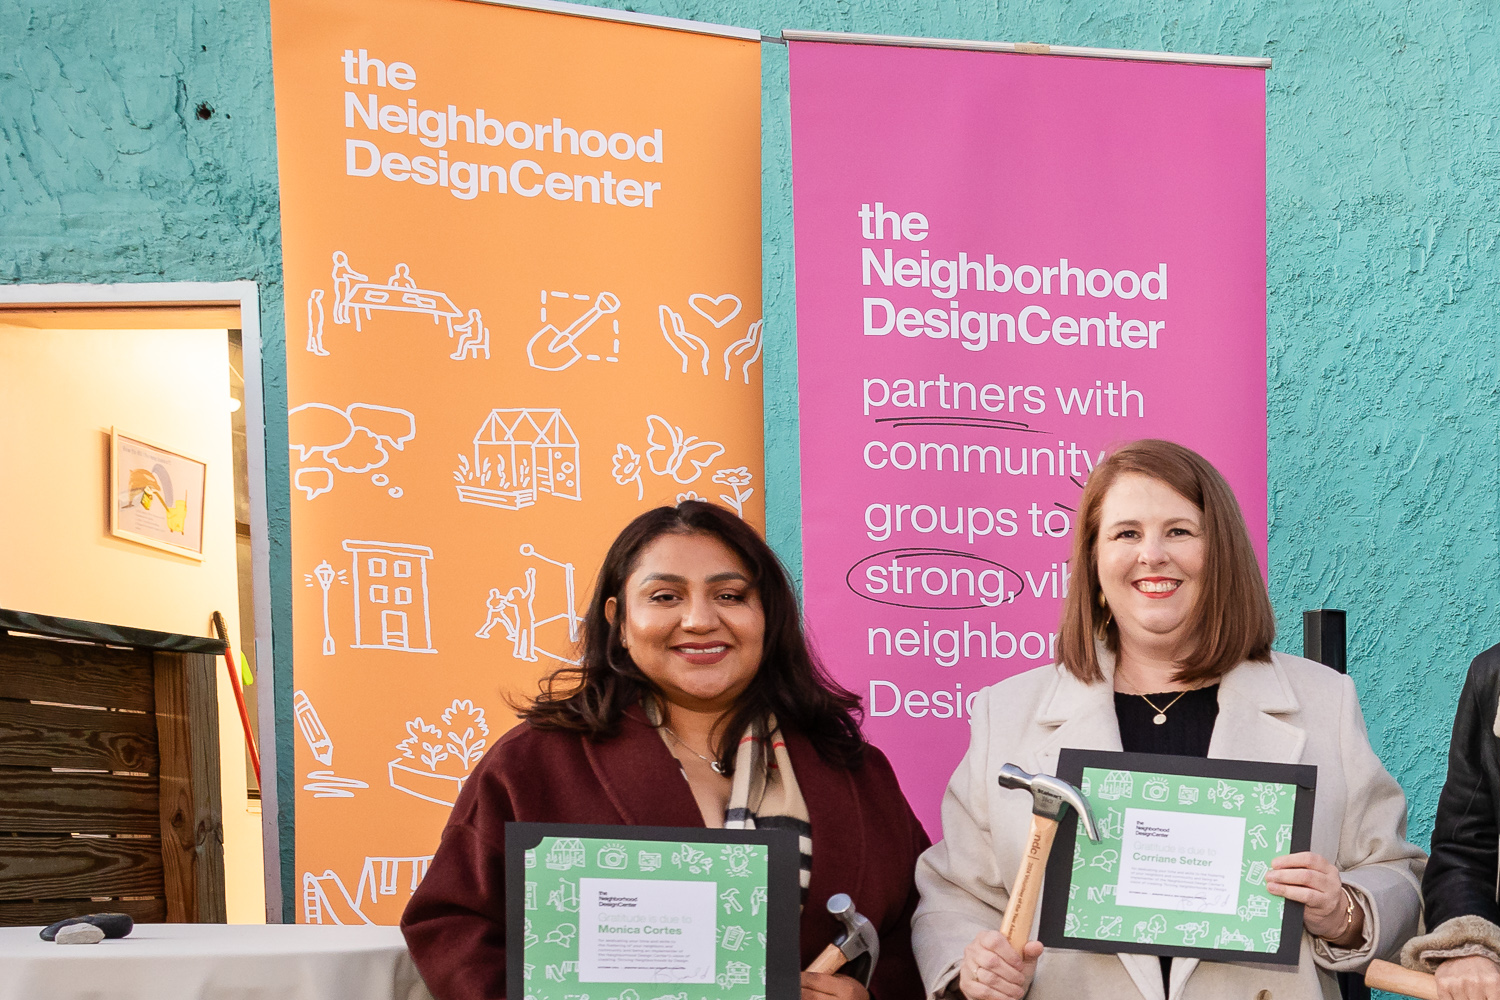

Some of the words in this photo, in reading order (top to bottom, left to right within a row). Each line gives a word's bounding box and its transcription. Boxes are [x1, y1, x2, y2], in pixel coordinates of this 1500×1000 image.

[341, 49, 416, 91] the
[344, 92, 663, 164] Neighborhood
[345, 139, 661, 208] DesignCenter
[858, 202, 929, 241] the
[861, 248, 1168, 300] Neighborhood
[863, 298, 1165, 352] DesignCenter
[863, 377, 1046, 416] partners
[1056, 380, 1144, 418] with
[865, 502, 1017, 543] groups
[1028, 502, 1070, 538] to
[865, 561, 1015, 606] strong,
[1132, 852, 1177, 864] Corriane
[1179, 856, 1213, 867] Setzer
[598, 924, 640, 934] Monica
[643, 925, 682, 935] Cortes
